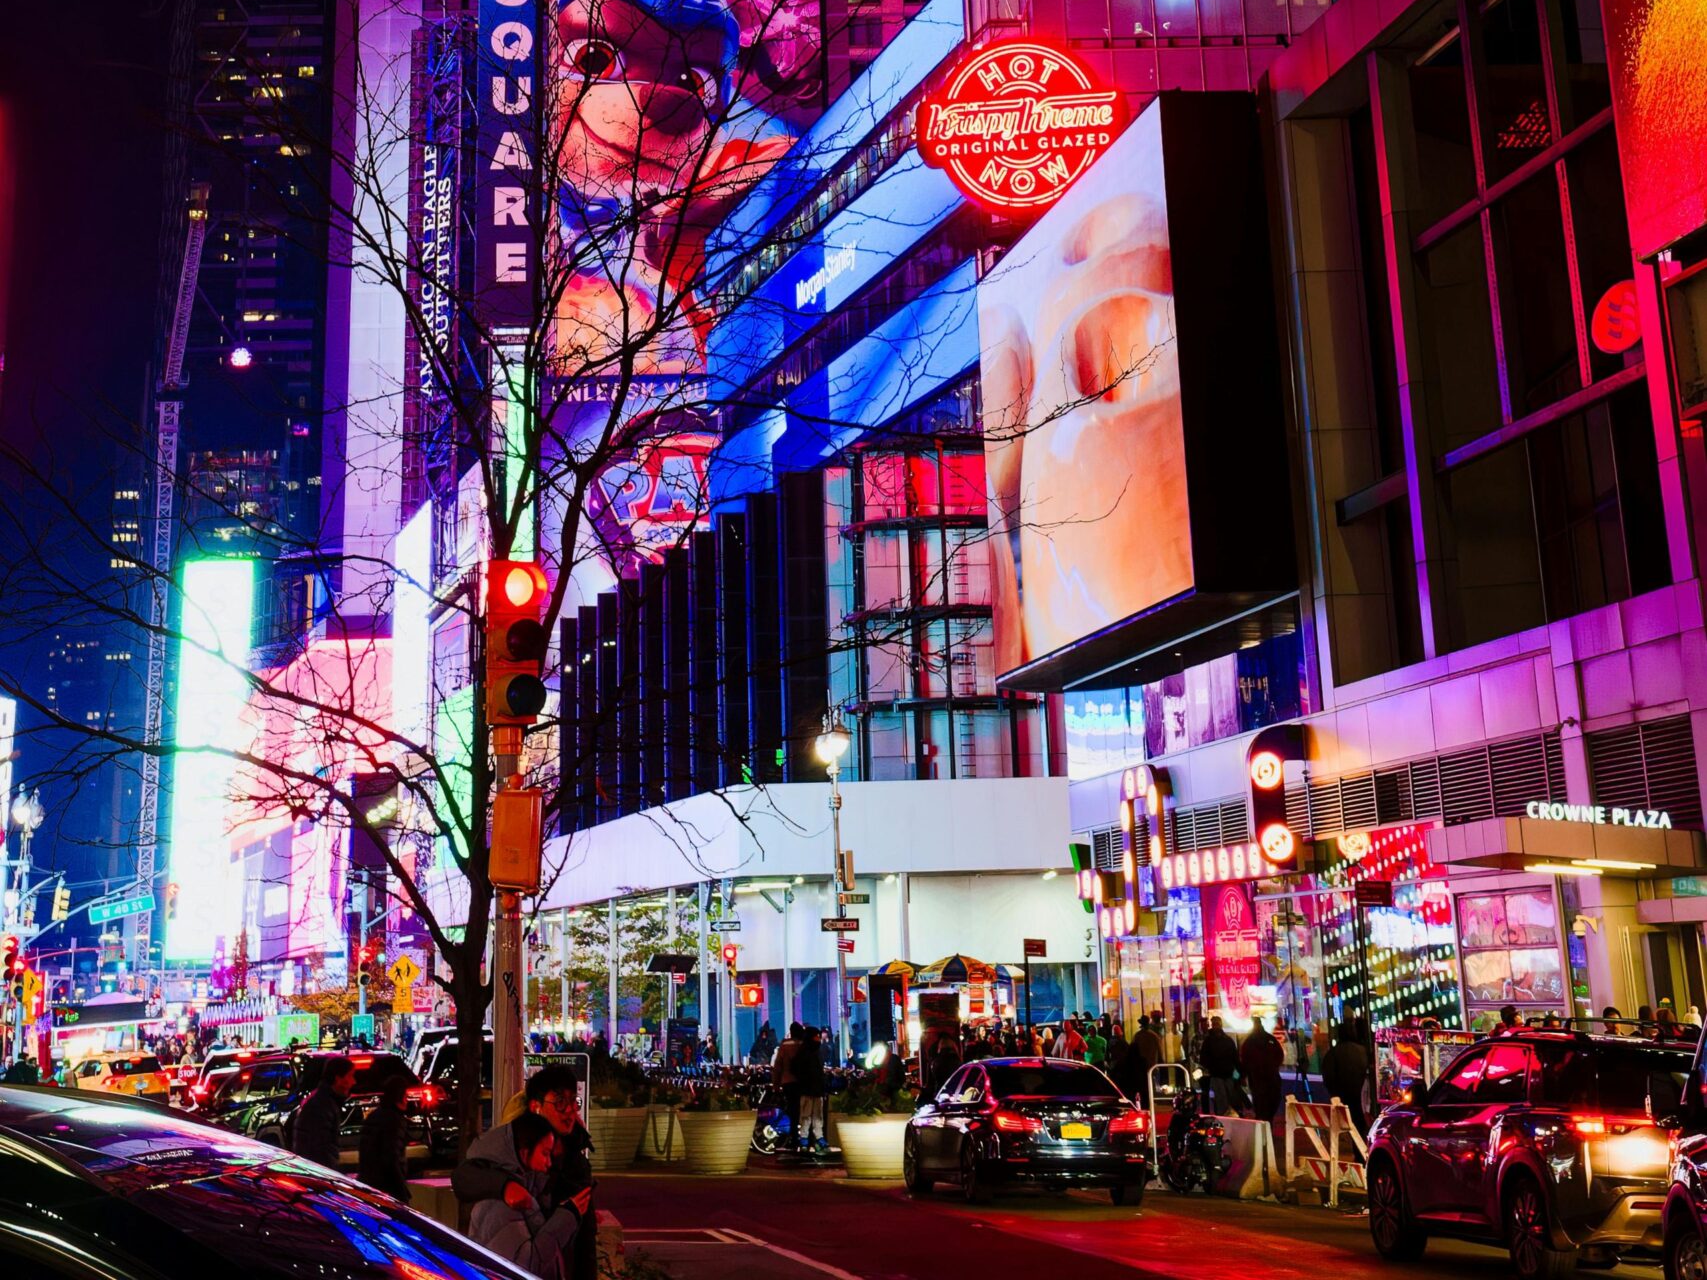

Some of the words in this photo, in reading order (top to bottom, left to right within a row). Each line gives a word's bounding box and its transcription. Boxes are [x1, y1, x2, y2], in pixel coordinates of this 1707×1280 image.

[976, 54, 1060, 92] HOT
[926, 98, 1024, 141] Krispy
[1021, 91, 1117, 135] Kreme
[935, 138, 1029, 156] ORIGINAL
[1037, 132, 1110, 150] GLAZED
[423, 144, 438, 234] EAGLE
[978, 154, 1071, 195] NOW
[796, 267, 826, 310] Morgan
[825, 239, 857, 283] Stanley
[1526, 801, 1606, 825] CROWNE
[1612, 807, 1672, 829] PLAZA
[179, 1069, 196, 1078] STOP
